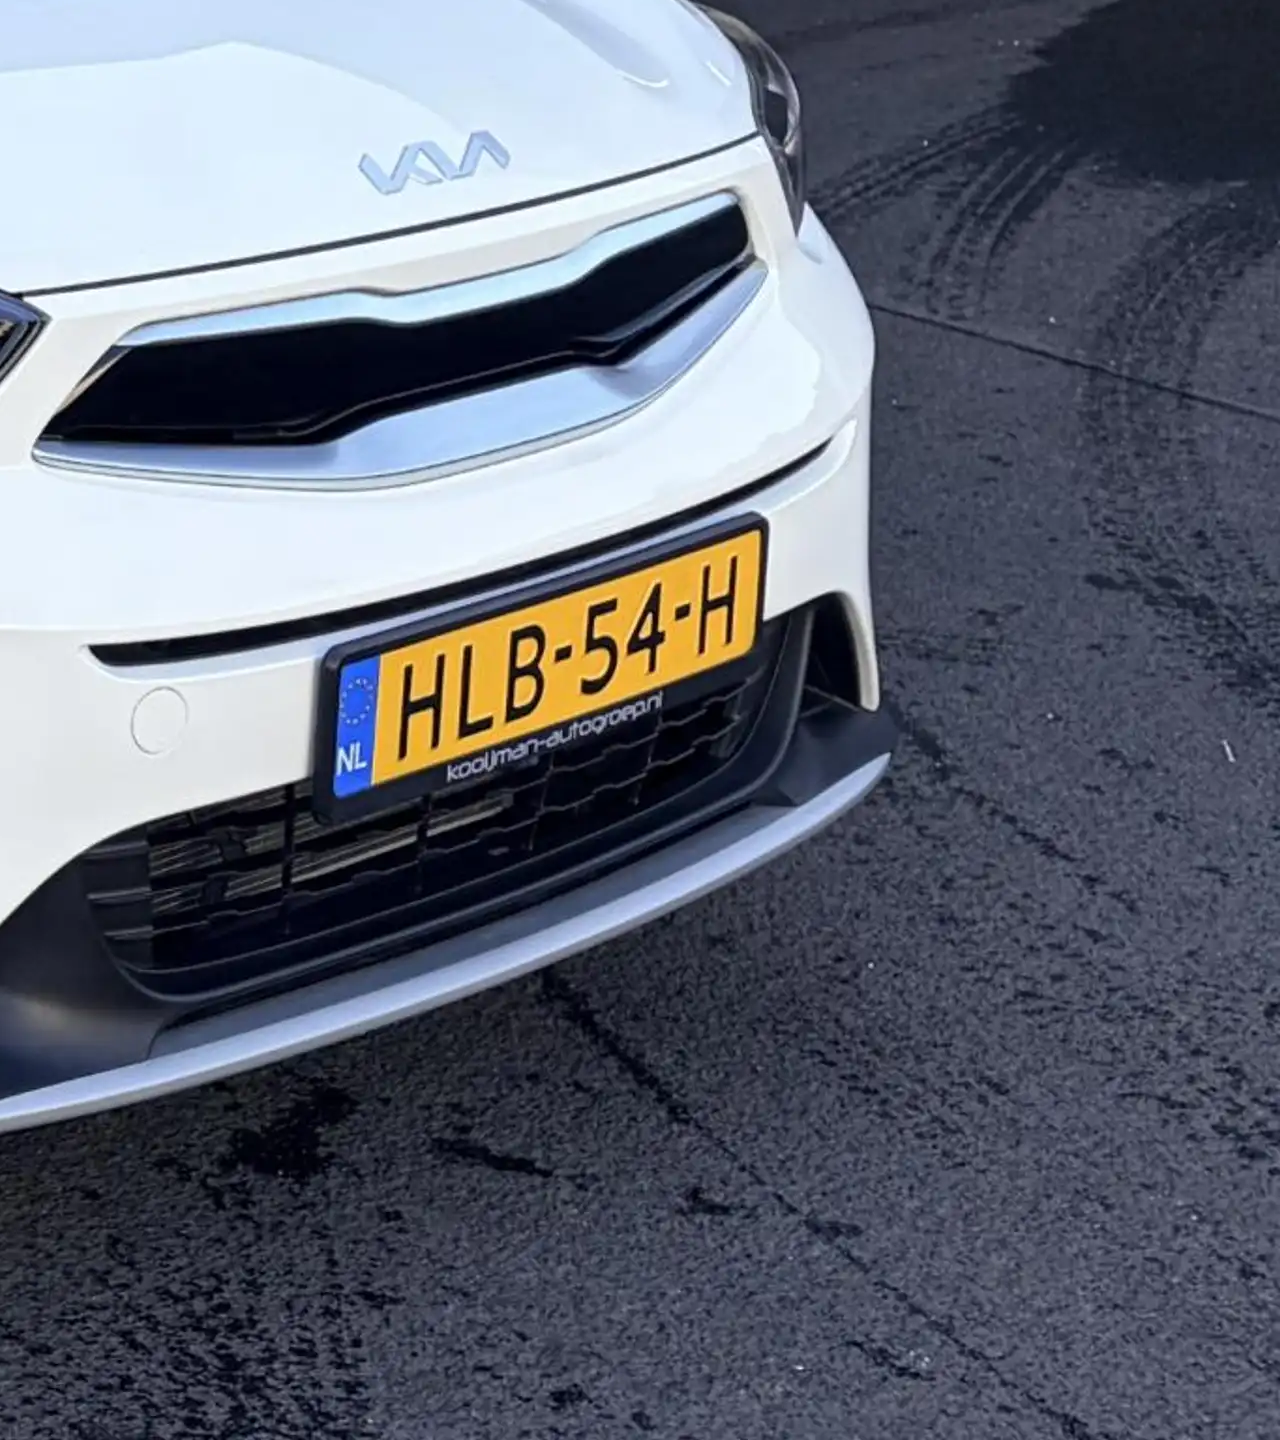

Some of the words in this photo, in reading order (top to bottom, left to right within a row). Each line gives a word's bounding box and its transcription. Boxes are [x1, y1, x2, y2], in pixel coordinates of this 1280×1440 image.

[397, 555, 740, 763] HLB-54-H
[335, 740, 368, 777] NL
[445, 690, 664, 783] kooijman-autogroep.nl
